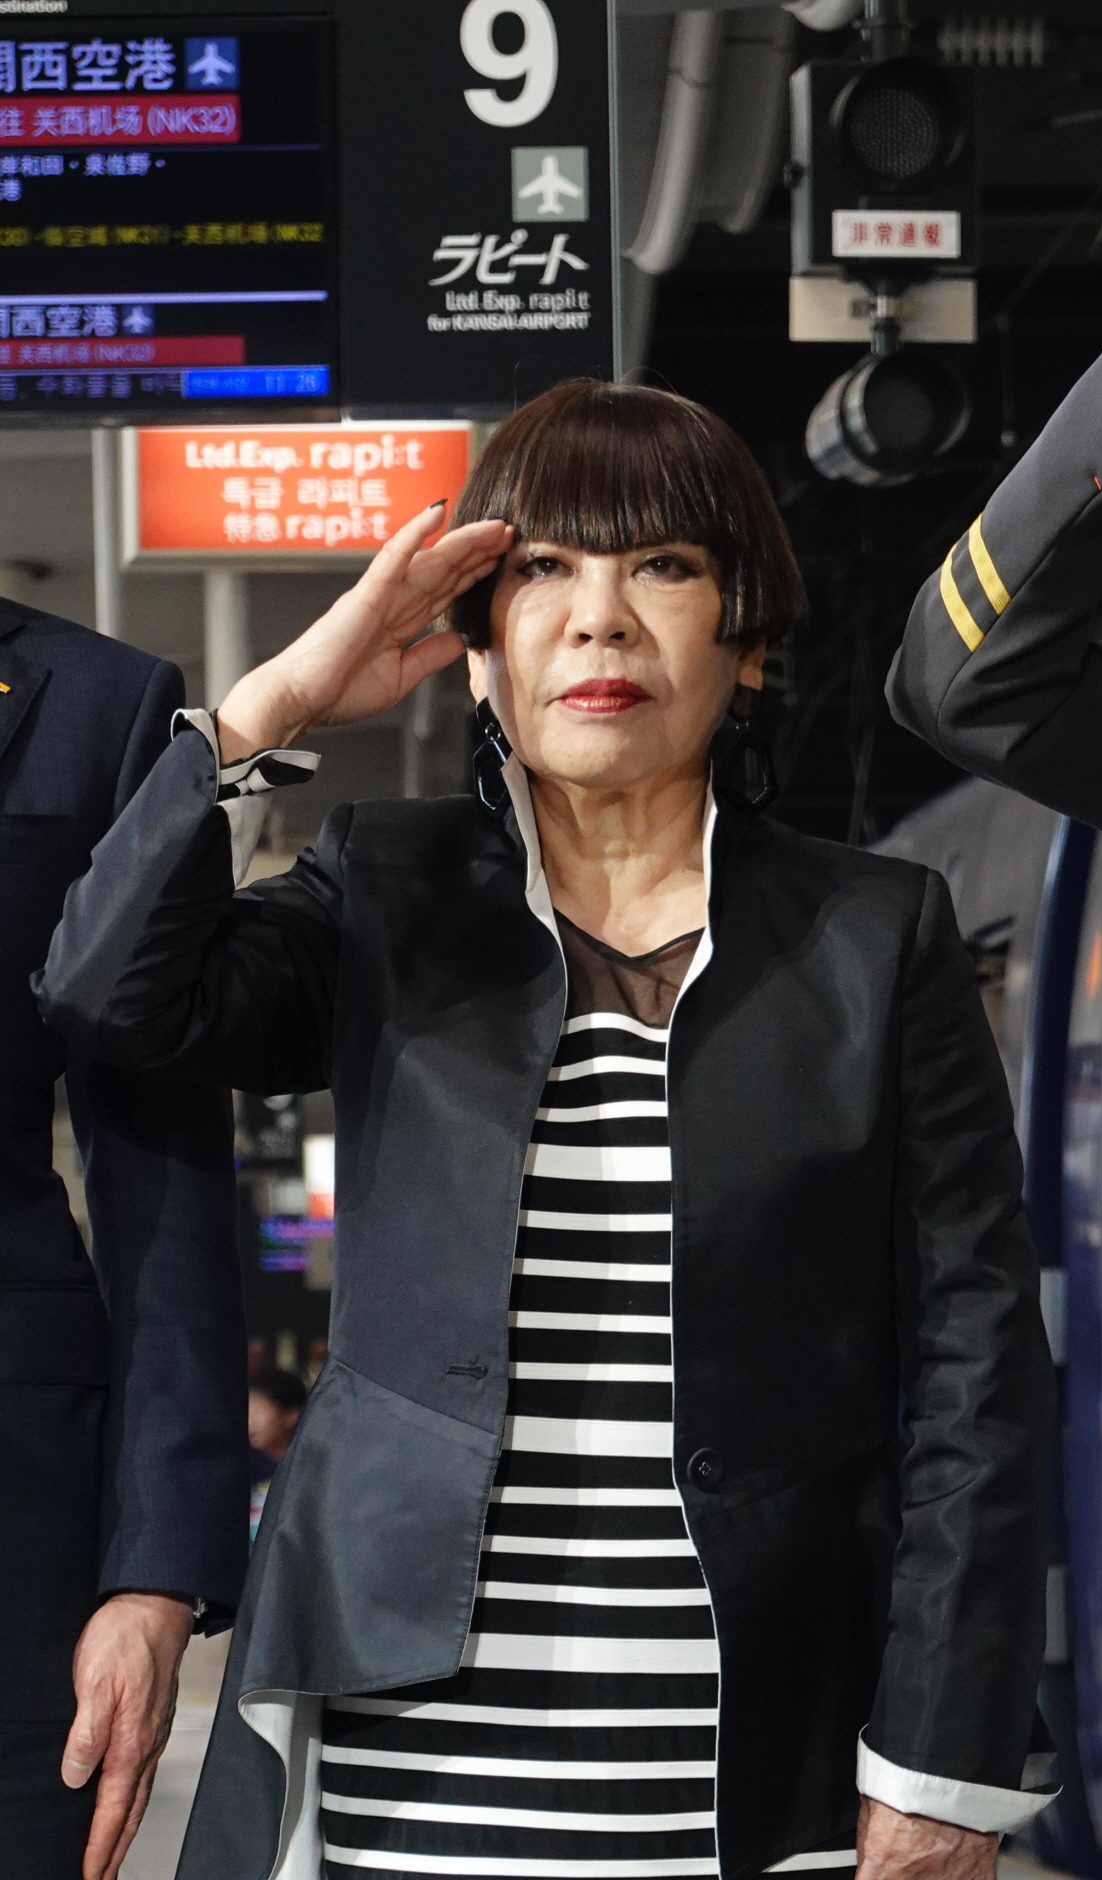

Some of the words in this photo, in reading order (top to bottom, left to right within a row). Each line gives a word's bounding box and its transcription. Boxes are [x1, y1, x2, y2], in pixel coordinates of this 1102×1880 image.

[459, 0, 559, 128] 9
[428, 228, 590, 286] ラピート
[427, 313, 451, 331] for
[220, 476, 285, 510] 특급
[297, 476, 392, 510] 라피트
